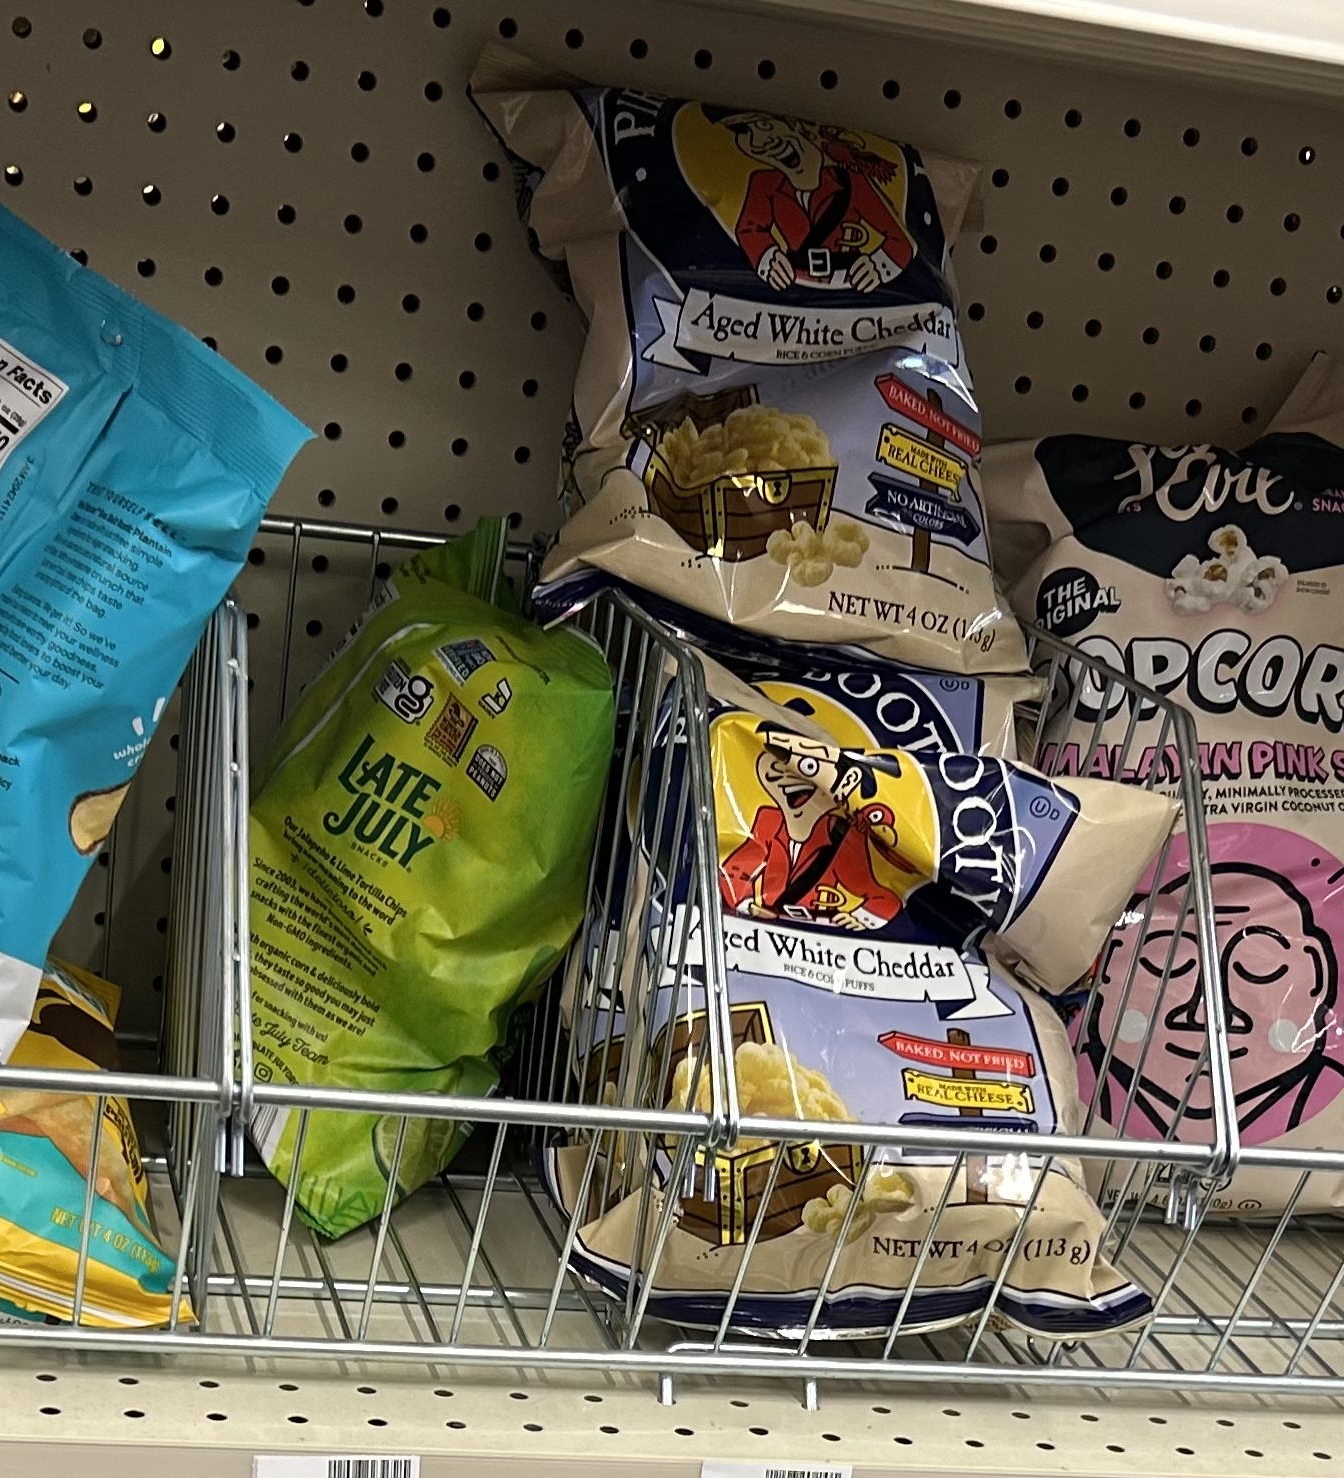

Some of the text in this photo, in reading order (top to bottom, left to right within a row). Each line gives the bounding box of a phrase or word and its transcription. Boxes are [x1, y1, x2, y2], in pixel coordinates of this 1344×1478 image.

[690, 303, 953, 347] Aged White Cheddar
[7, 365, 52, 405] Facts
[1043, 576, 1087, 606] THE
[827, 590, 950, 636] NET WT 4 OZ
[338, 734, 441, 819] LATE
[1215, 786, 1286, 799] MINIMALLY
[1231, 801, 1278, 814] VIRGIN
[1282, 800, 1337, 812] COCONUT
[323, 794, 435, 869] JULY
[895, 1039, 1025, 1072] BAKED, NOT FRIED
